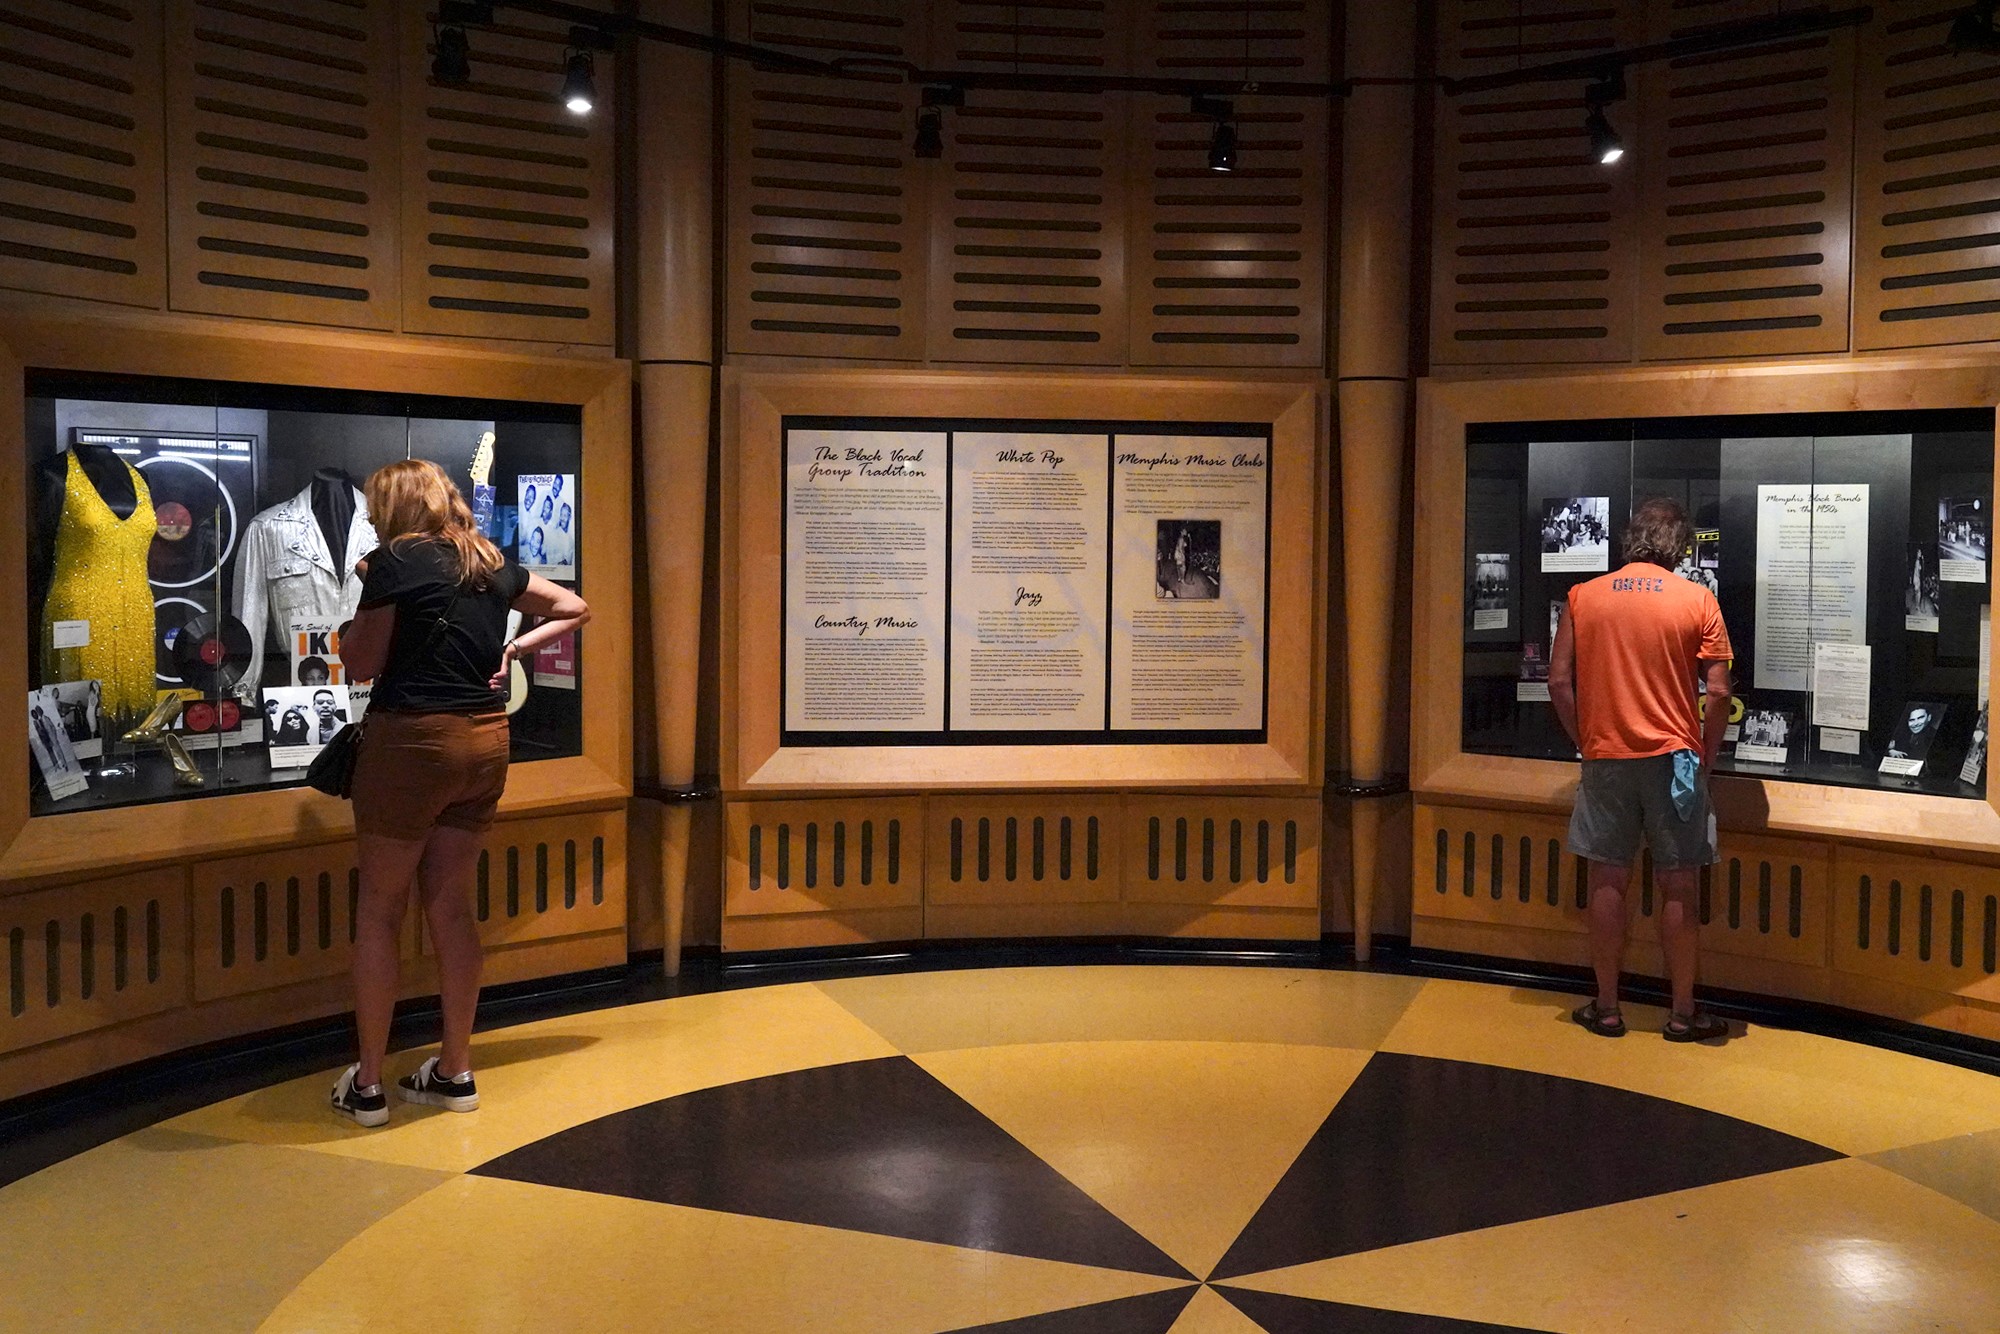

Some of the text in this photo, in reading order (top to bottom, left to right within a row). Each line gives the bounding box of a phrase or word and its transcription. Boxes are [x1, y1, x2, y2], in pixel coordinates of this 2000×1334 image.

[815, 446, 924, 462] The Black Vocal
[996, 449, 1065, 469] White Pop
[1117, 452, 1264, 470] Memphis Music Clubs
[808, 462, 927, 482] Group Tradition
[1765, 494, 1804, 505] Memphis
[1834, 494, 1862, 503] Bands
[1612, 577, 1663, 592] ORTIZ
[1014, 586, 1043, 607] Jazz
[306, 623, 323, 631] Soul
[325, 624, 332, 632] of
[814, 615, 918, 636] Country Music
